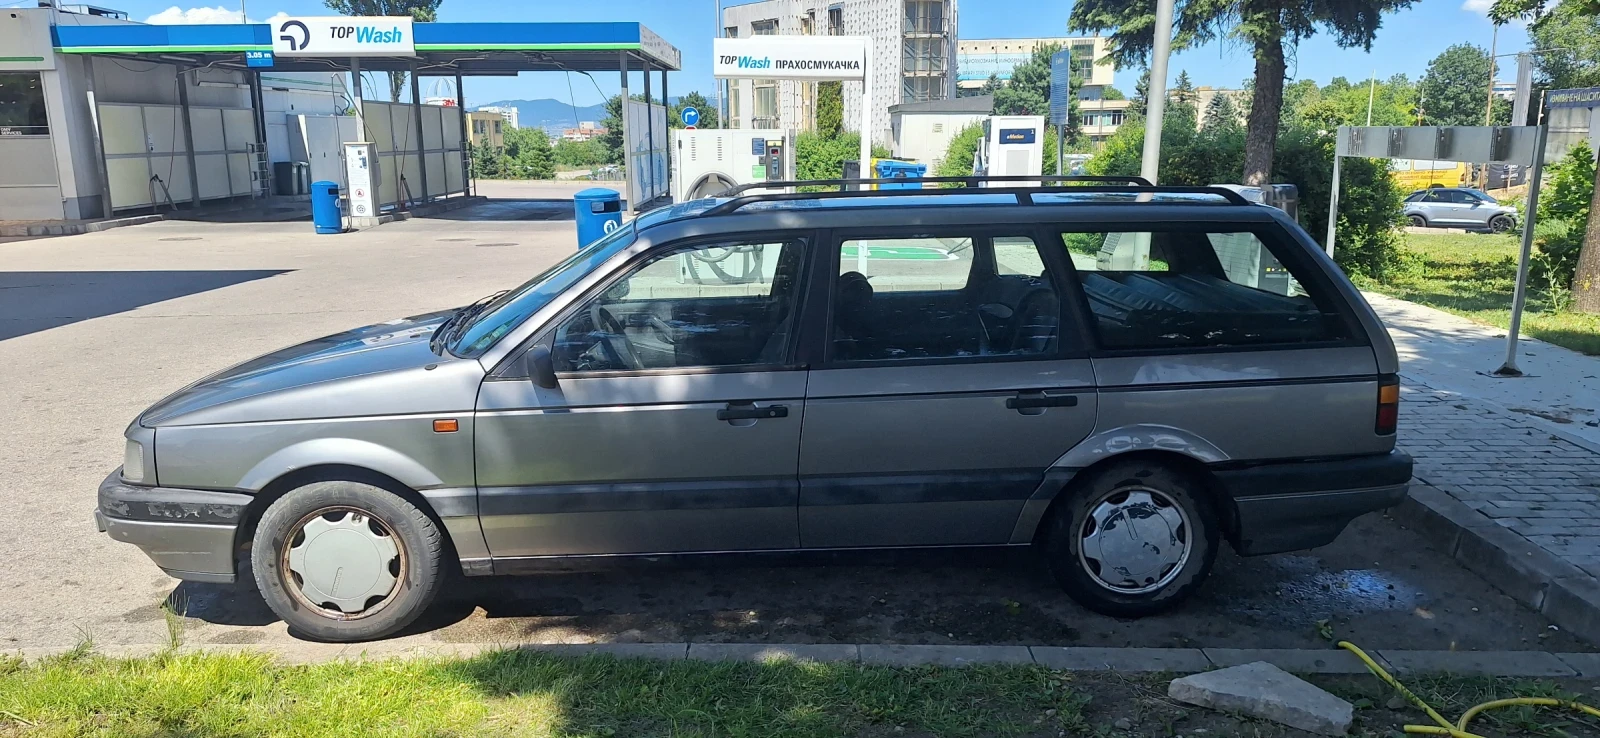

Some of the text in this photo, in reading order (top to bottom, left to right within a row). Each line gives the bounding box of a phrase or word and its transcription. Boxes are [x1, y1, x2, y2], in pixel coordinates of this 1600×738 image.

[330, 26, 402, 43] TOP Wash
[719, 55, 770, 69] TOP Wash
[775, 60, 860, 70] ПРАХОСМУКАЧКА
